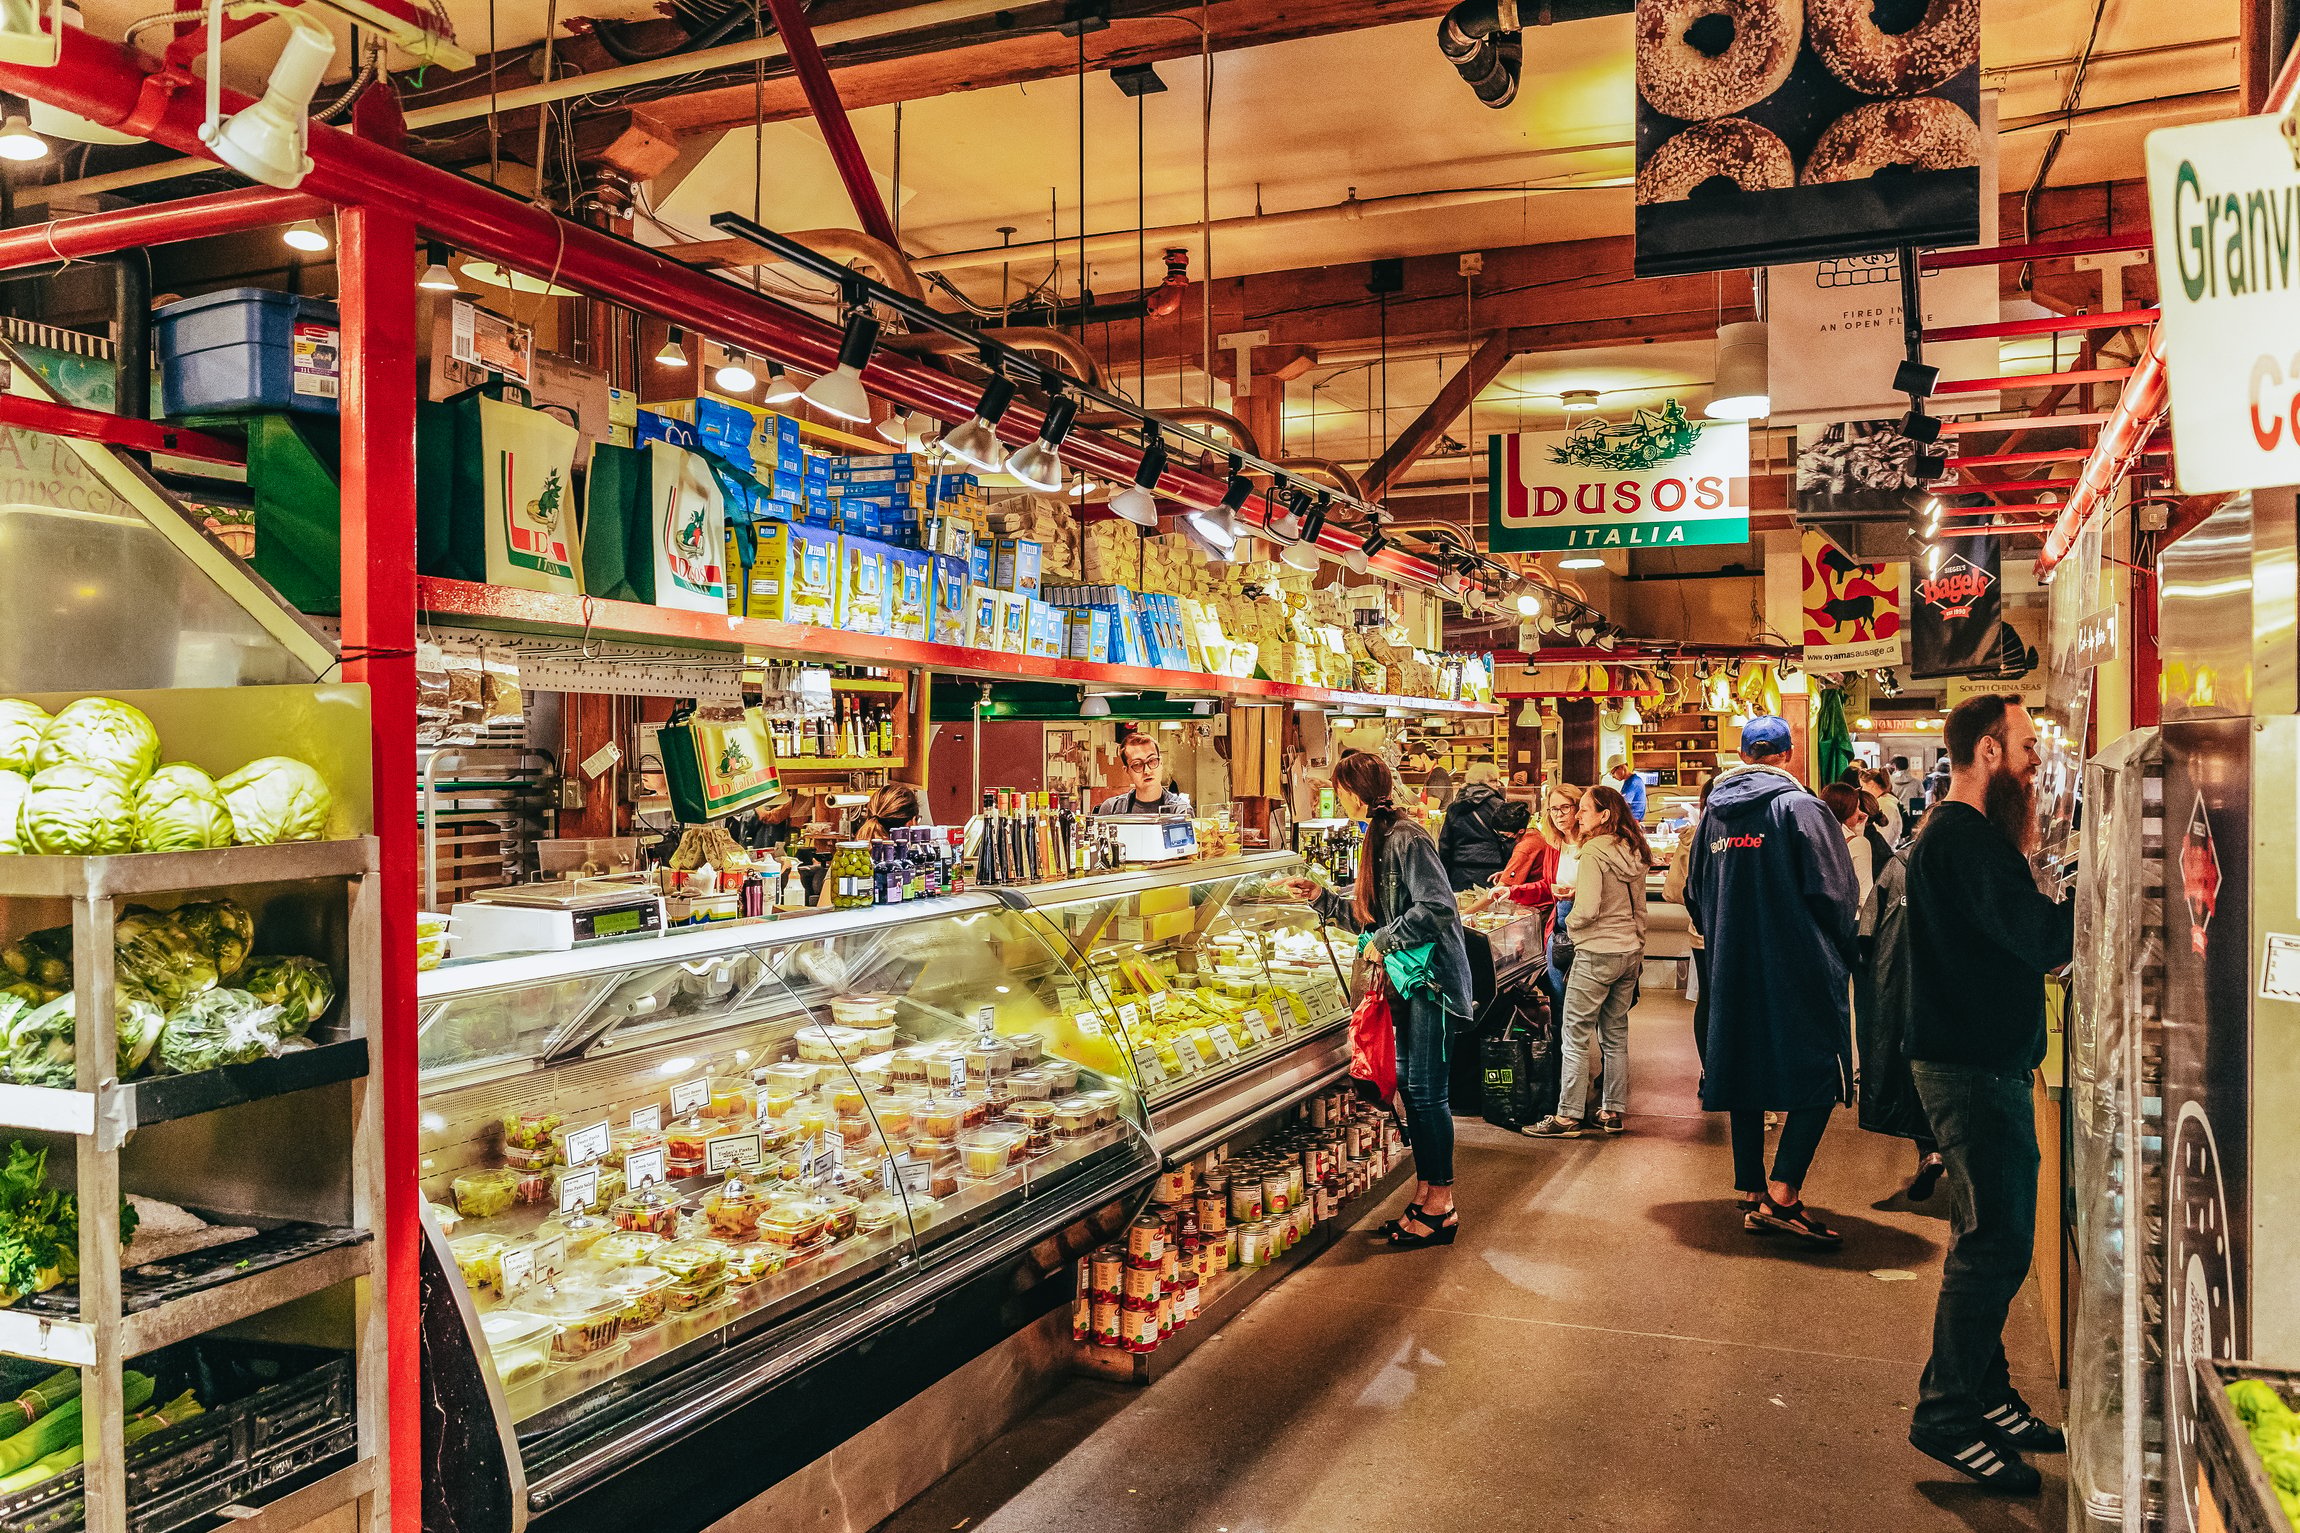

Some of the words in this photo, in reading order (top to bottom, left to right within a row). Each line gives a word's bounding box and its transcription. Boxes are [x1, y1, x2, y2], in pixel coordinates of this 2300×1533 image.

[2174, 159, 2300, 302] Granv
[1843, 308, 1883, 319] FIRED
[1820, 324, 1837, 332] AN
[1845, 320, 1880, 330] OPEN
[1889, 314, 1934, 326] FLE
[1532, 475, 1724, 517] DUSO'S
[1568, 525, 1685, 546] ITALIA
[1944, 564, 1966, 574] SIEGEL'S
[1921, 567, 1988, 605] Bagels
[1954, 608, 1966, 616] 1990
[1807, 645, 1894, 662] www.oyamasausage.ca
[1960, 684, 1990, 693] SOUTH
[1991, 683, 2019, 692] CHINA
[2021, 683, 2041, 691] SEAS
